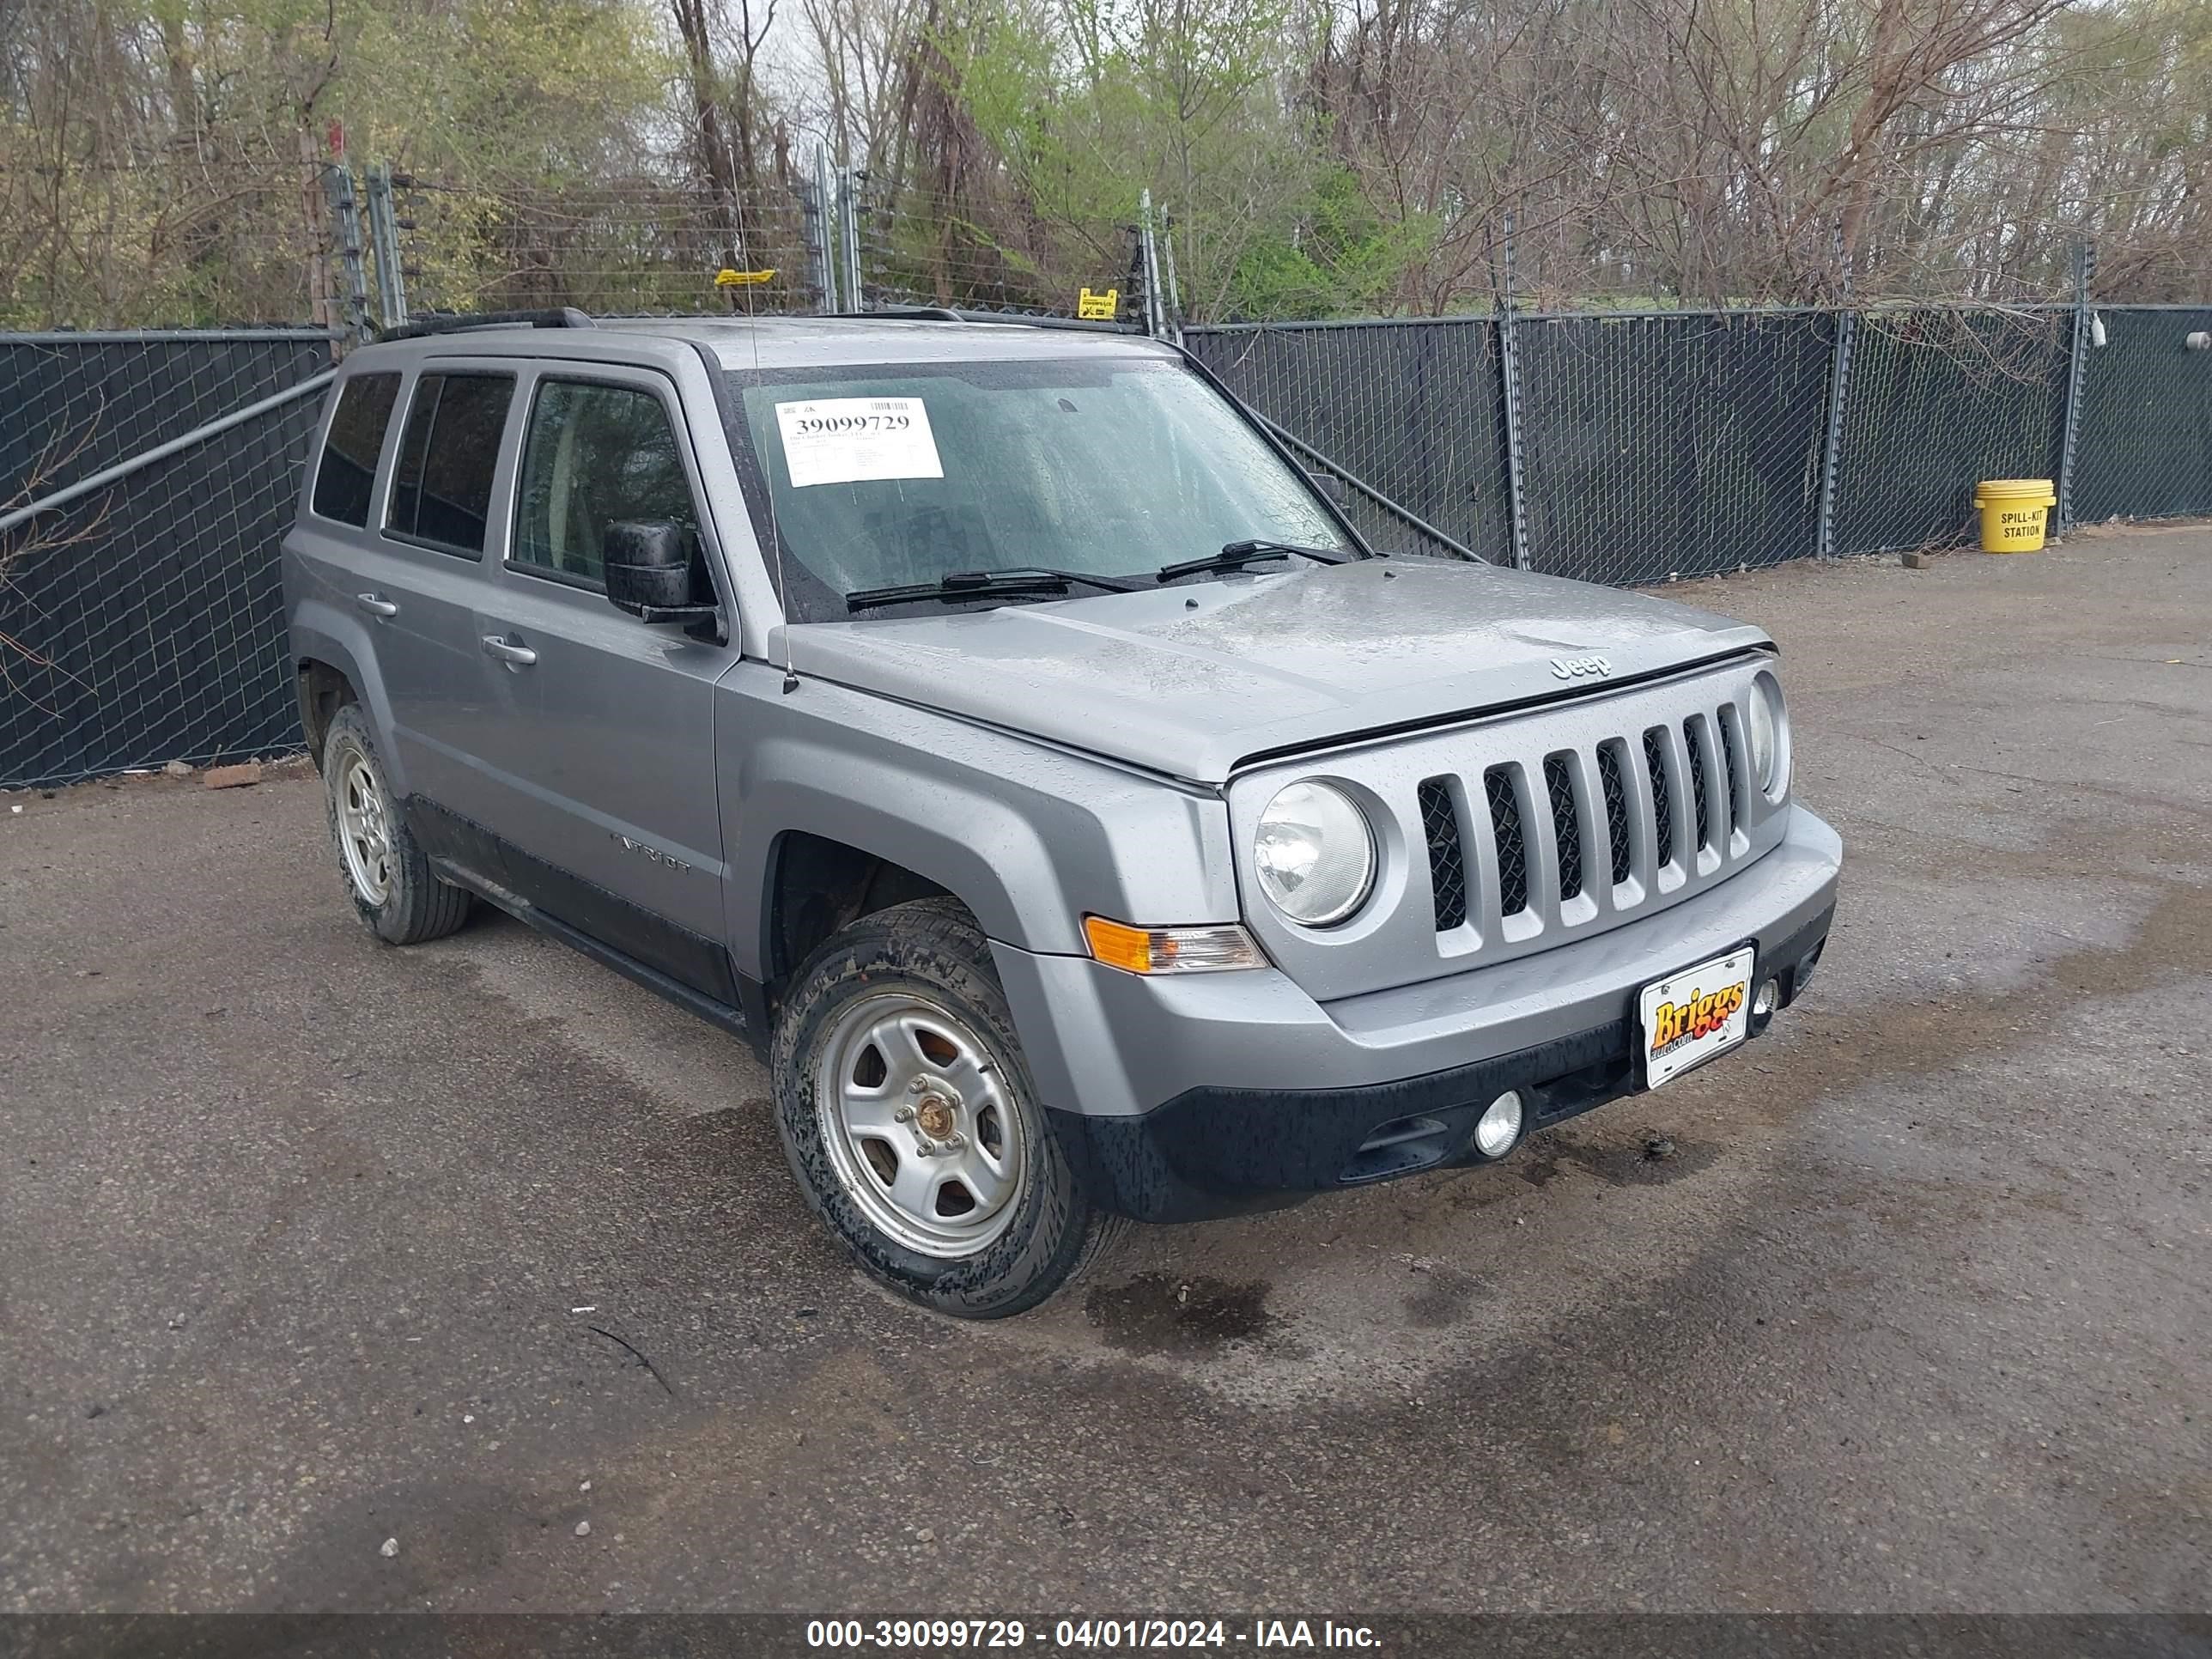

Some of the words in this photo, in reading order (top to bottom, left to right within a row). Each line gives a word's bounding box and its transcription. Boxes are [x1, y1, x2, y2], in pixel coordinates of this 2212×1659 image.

[795, 416, 910, 434] 39099729
[2002, 510, 2043, 524] SPILL-KIT
[2004, 525, 2040, 538] STATION
[1550, 655, 1612, 680] Jeep
[1652, 981, 1745, 1048] Briggs
